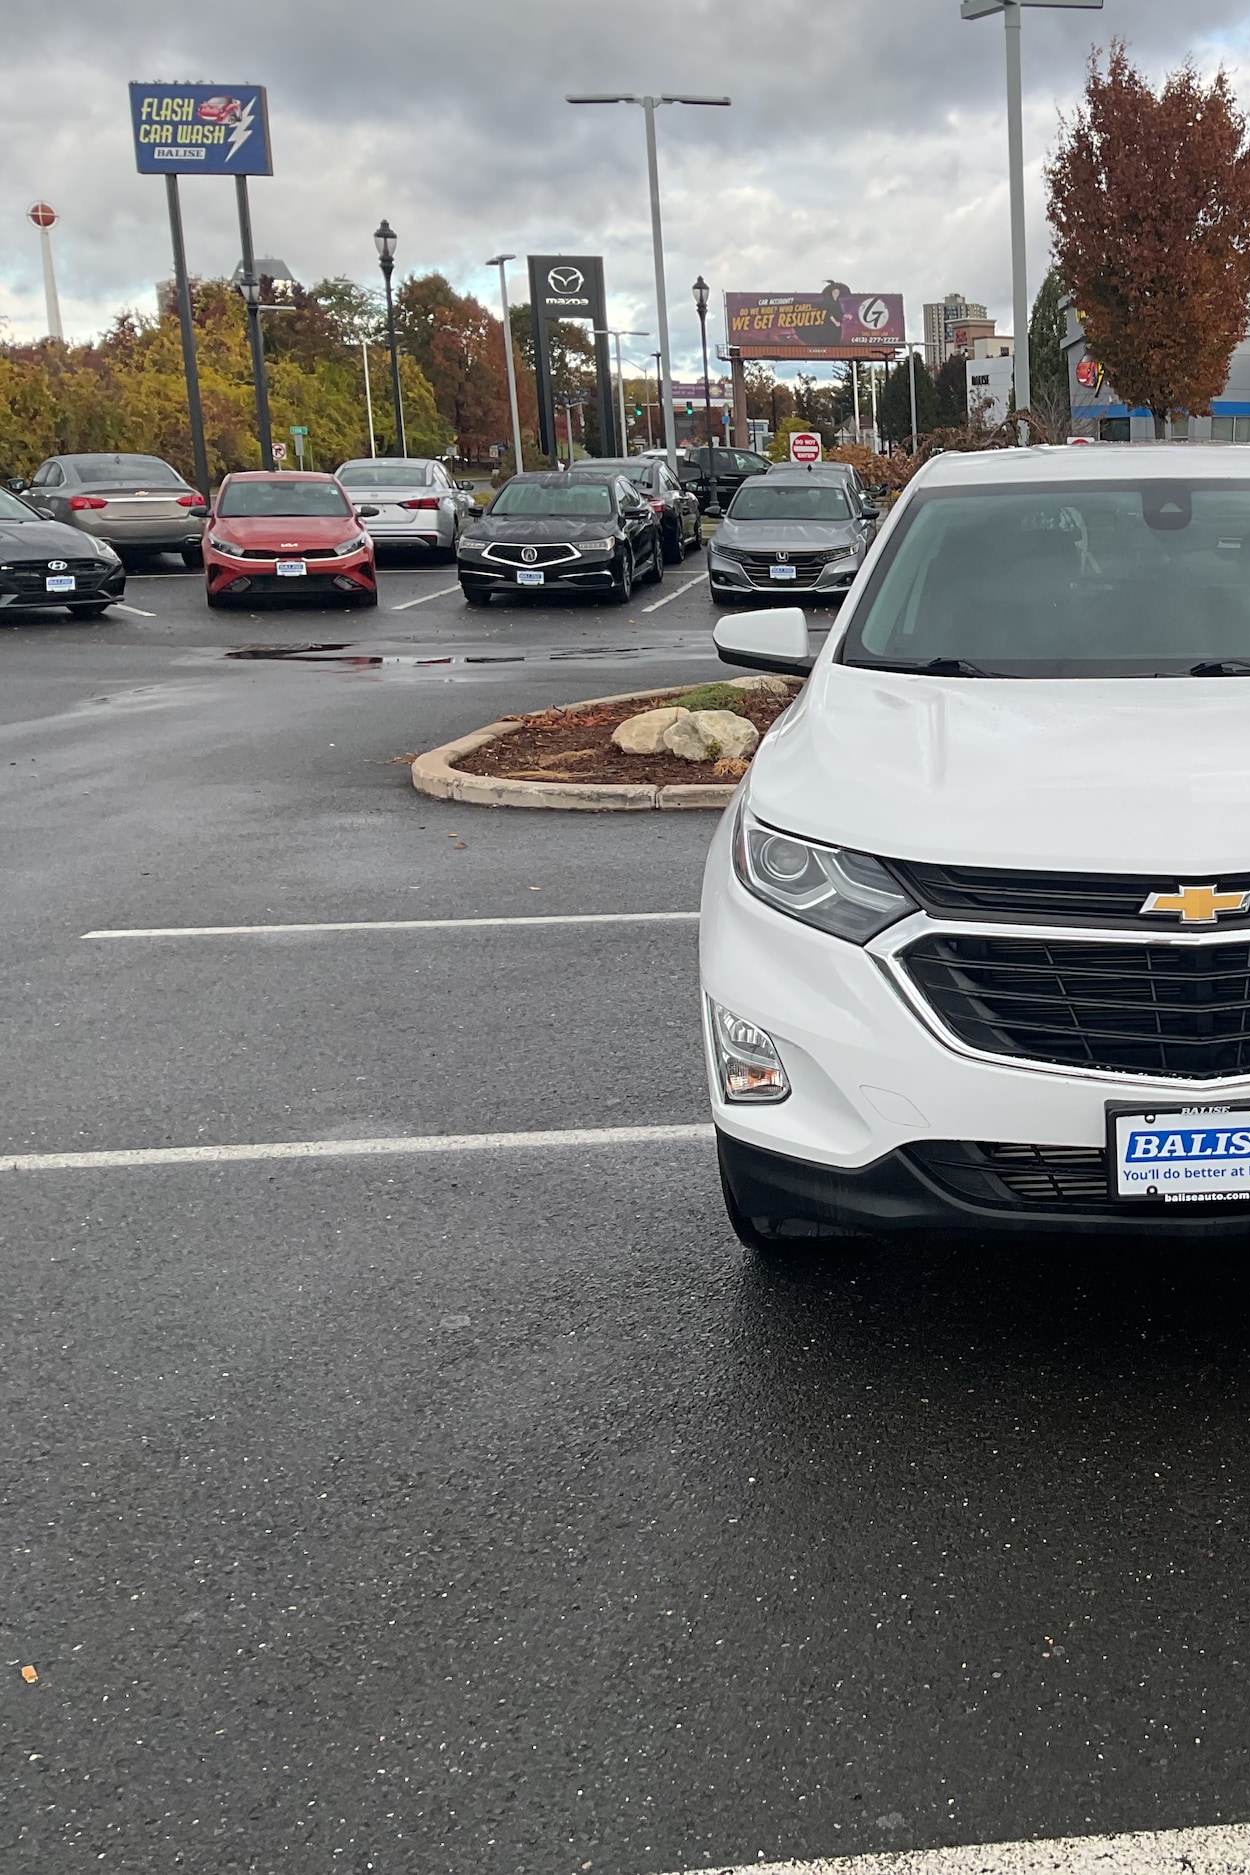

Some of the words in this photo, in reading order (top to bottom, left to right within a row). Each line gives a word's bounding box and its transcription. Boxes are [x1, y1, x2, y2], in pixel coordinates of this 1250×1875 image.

[141, 98, 194, 121] FLASH
[139, 125, 173, 143] CAR
[177, 125, 226, 144] WASH
[157, 149, 204, 158] BALISE
[758, 298, 768, 306] CAR
[732, 316, 750, 331] WE
[754, 314, 775, 330] GET
[777, 310, 827, 328] RESULTS!
[1181, 1106, 1231, 1116] BALISE
[1123, 1168, 1160, 1181] You'll
[1163, 1168, 1180, 1179] do
[1185, 1166, 1227, 1178] better
[1231, 1166, 1245, 1177] at
[1164, 1192, 1250, 1202] baliseauto.com
